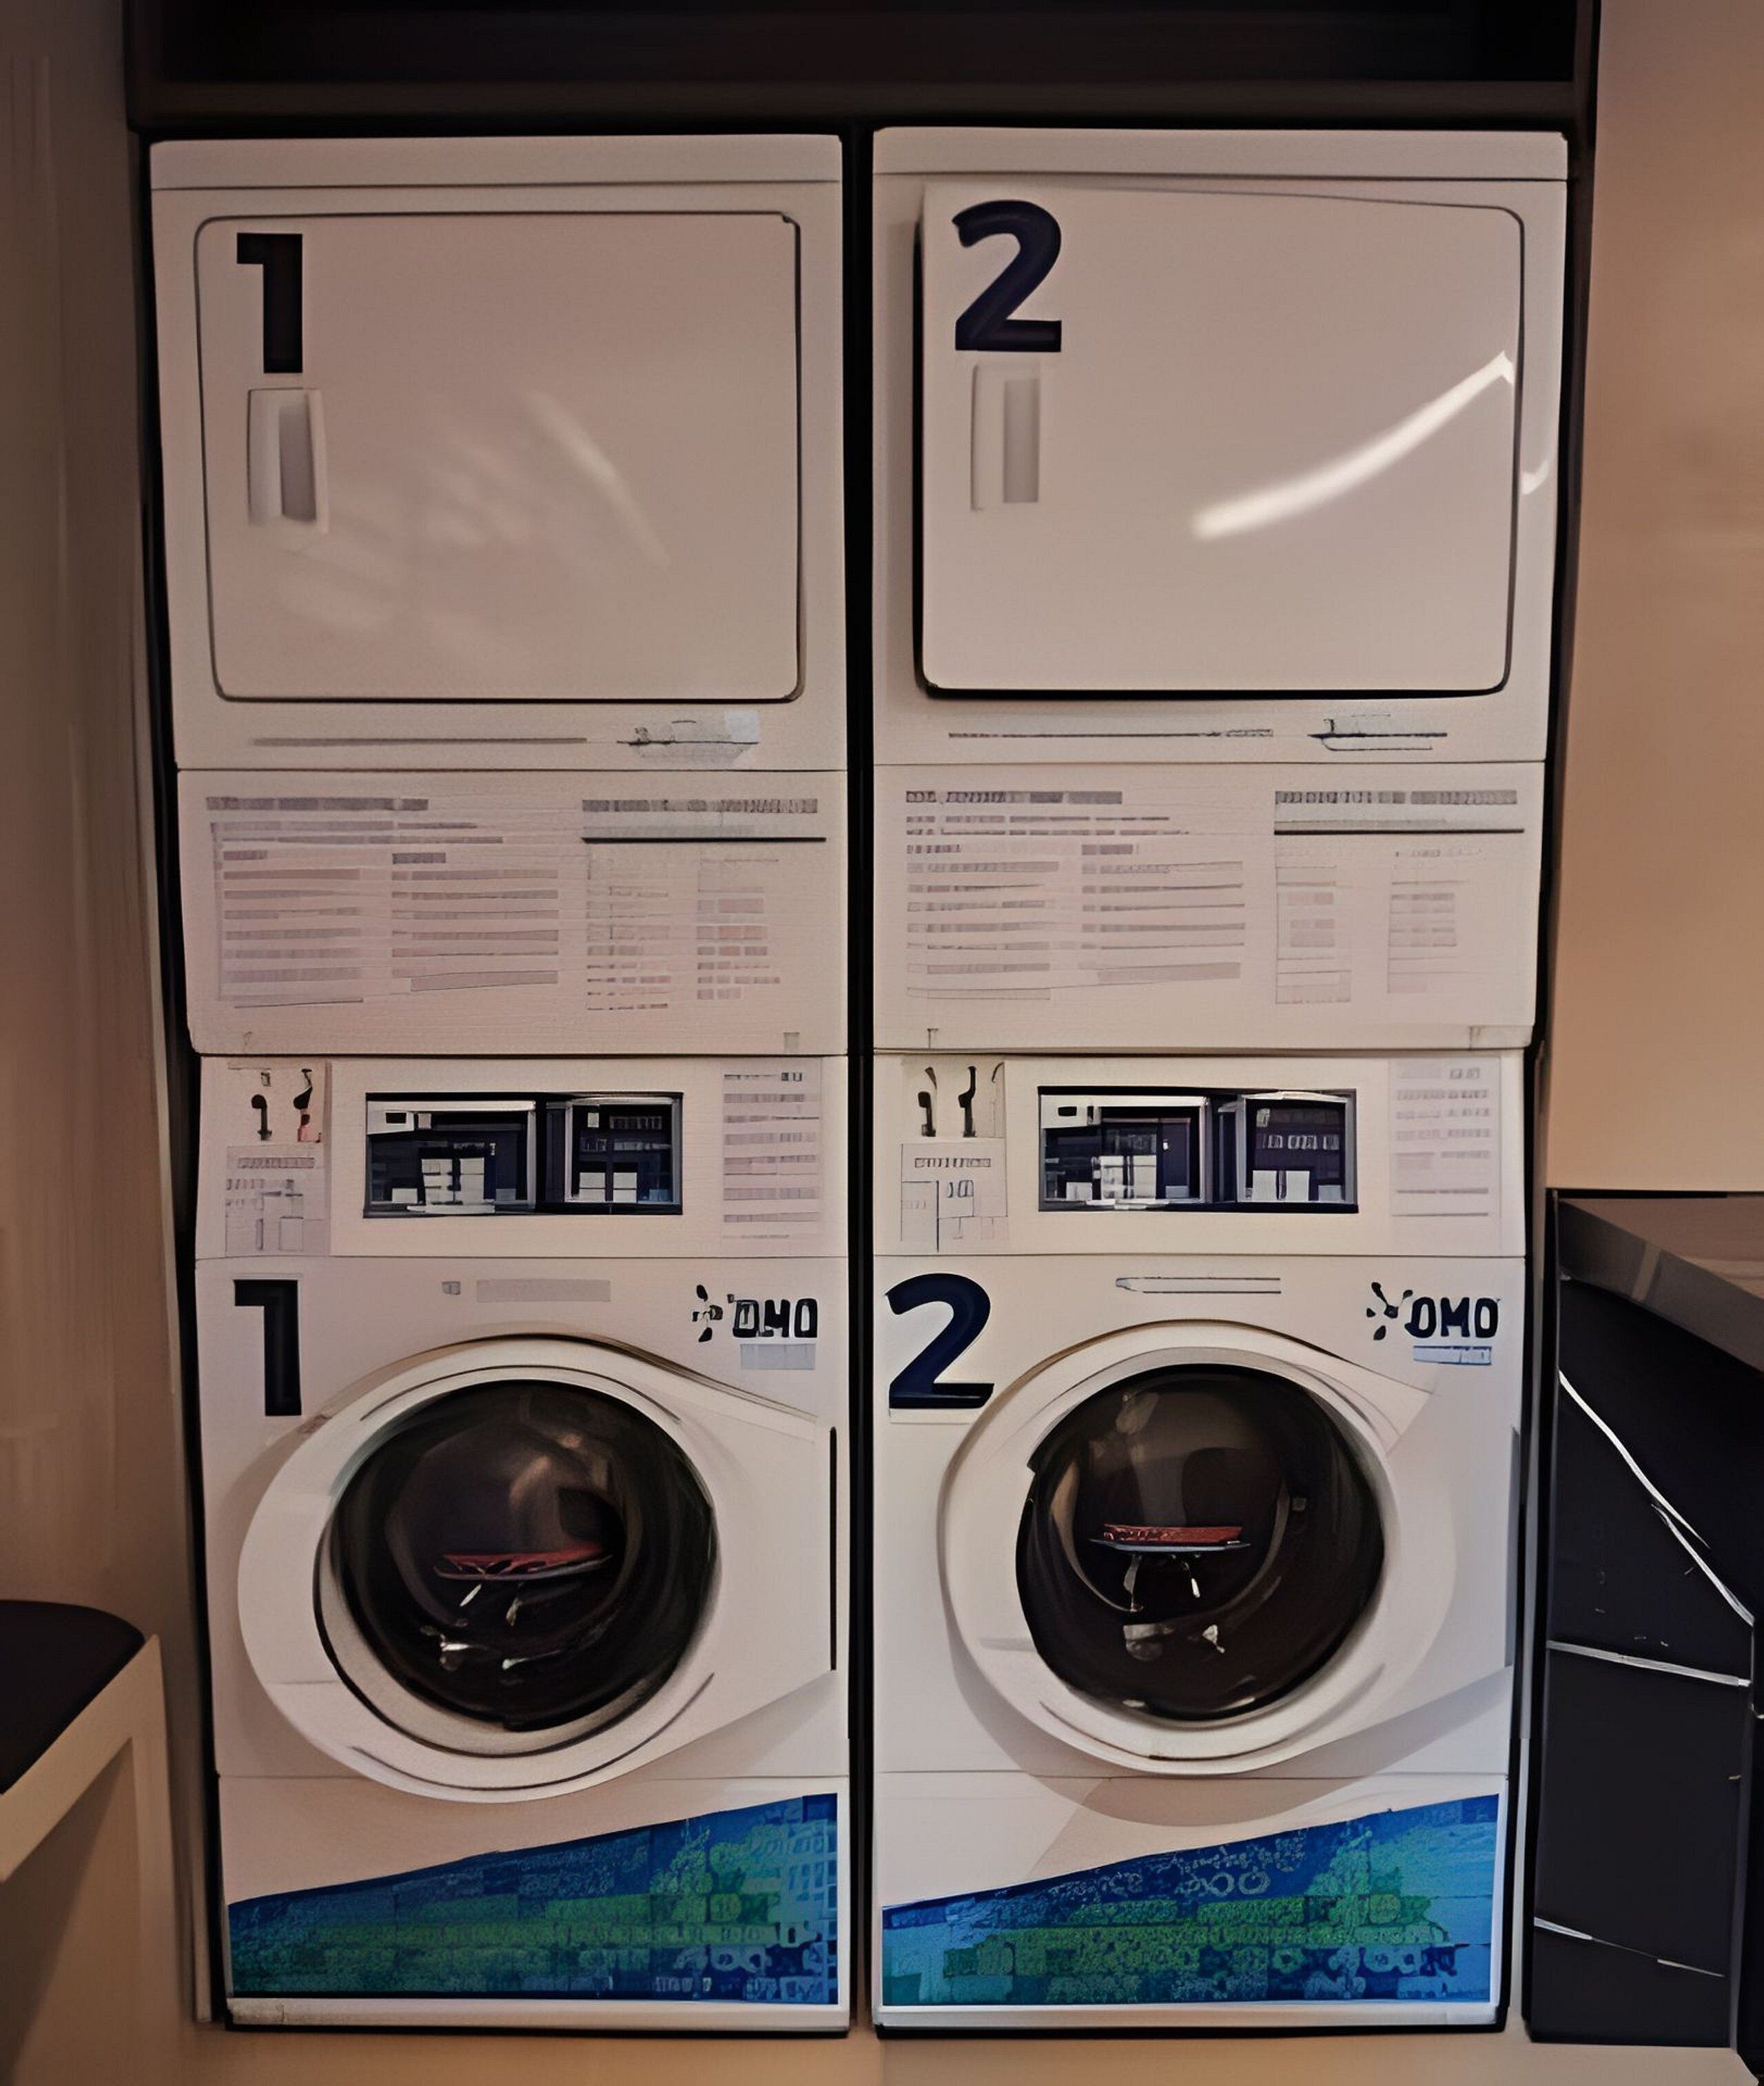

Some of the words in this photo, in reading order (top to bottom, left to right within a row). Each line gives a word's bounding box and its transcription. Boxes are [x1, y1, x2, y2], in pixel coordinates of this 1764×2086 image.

[237, 233, 302, 373] 1
[952, 199, 1062, 353] 2
[234, 1280, 302, 1417] 1
[886, 1273, 994, 1409] 2
[1404, 1296, 1499, 1338] OMO
